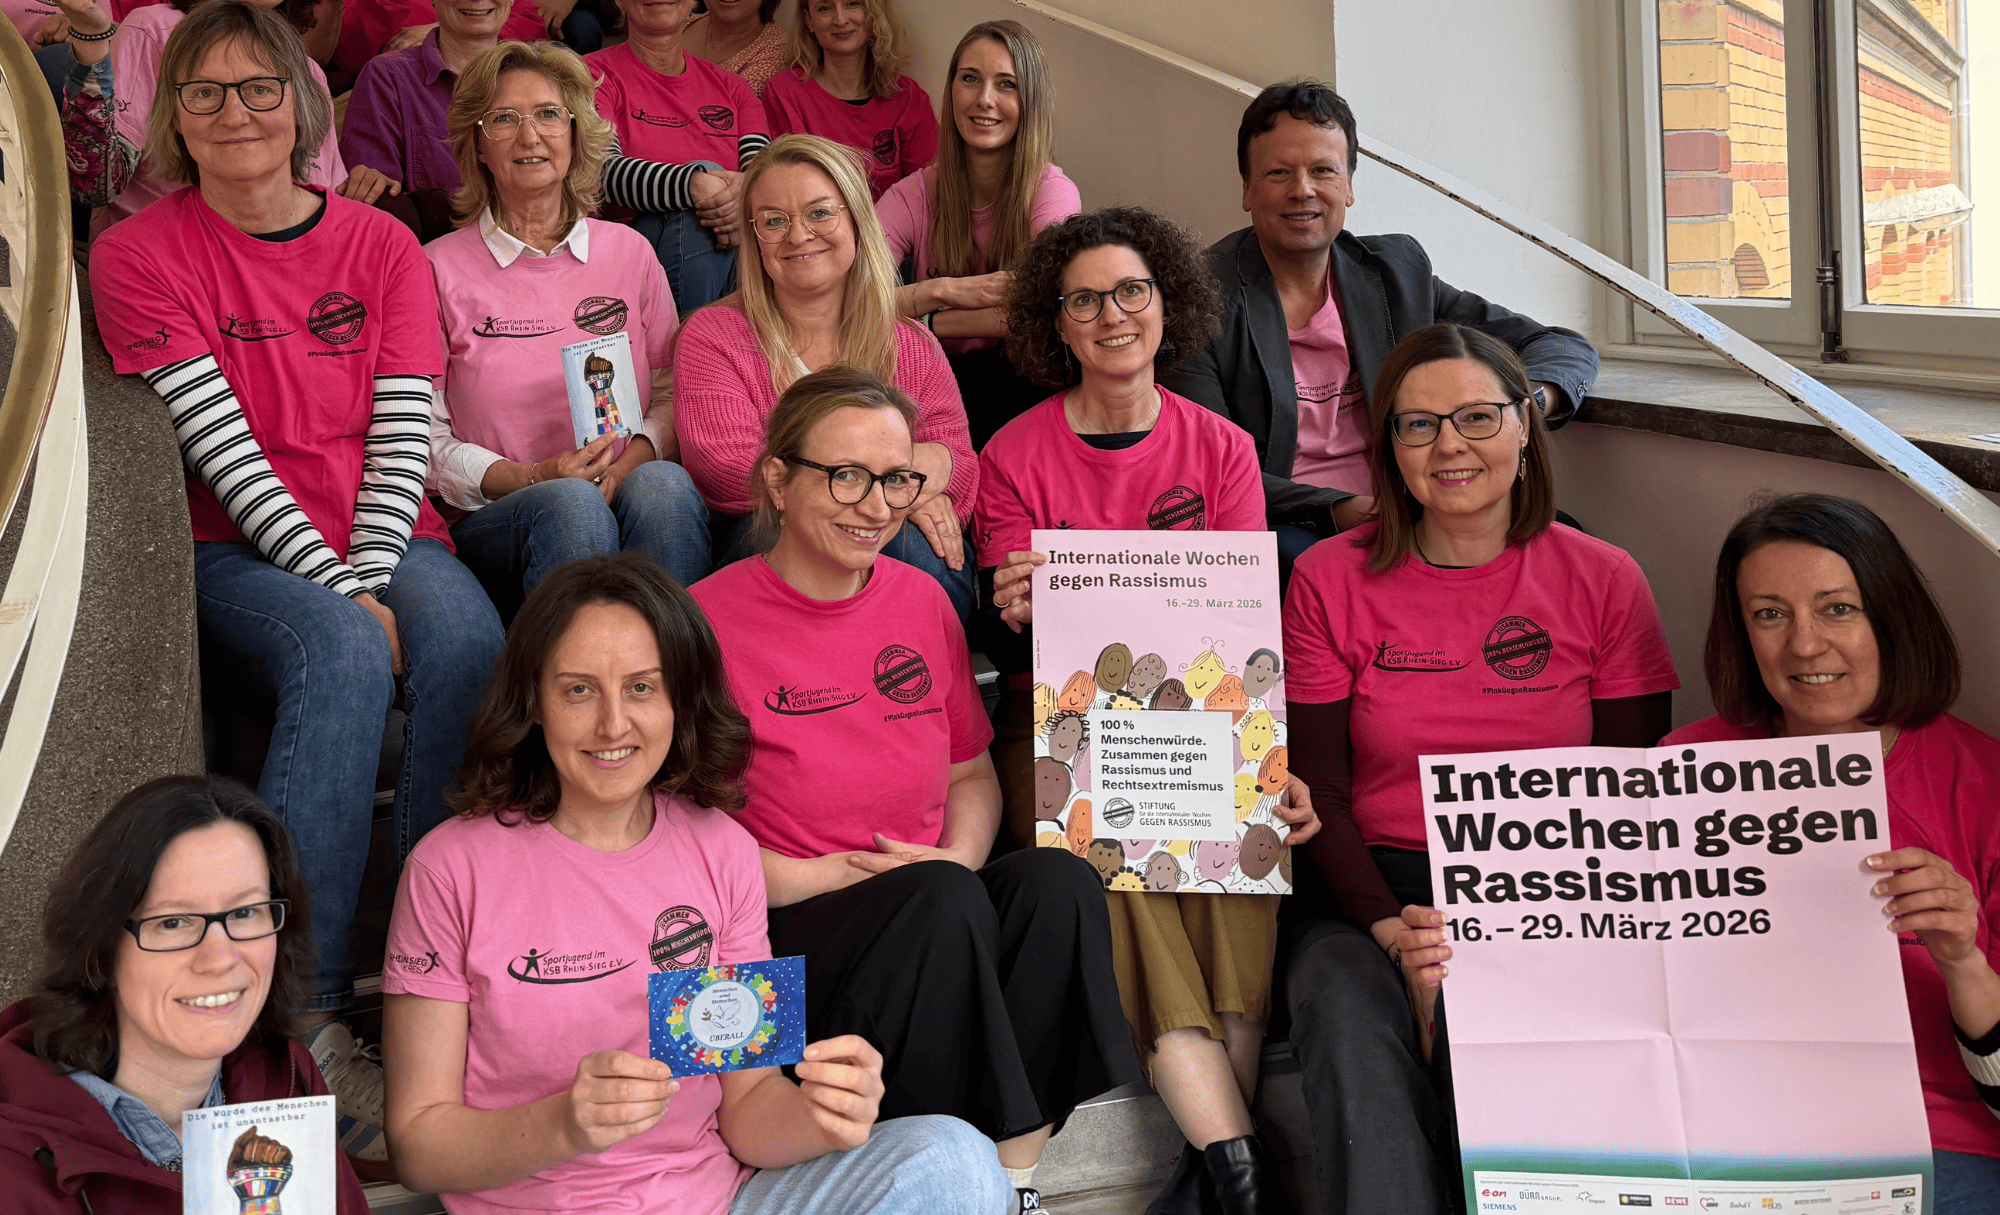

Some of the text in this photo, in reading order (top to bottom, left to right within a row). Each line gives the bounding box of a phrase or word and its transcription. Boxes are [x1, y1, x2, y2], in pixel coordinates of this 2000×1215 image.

[1049, 550, 1260, 566] Internationale Wochen
[1049, 572, 1208, 590] gegen Rassismus
[1206, 599, 1233, 608] März
[1237, 599, 1262, 608] 2026
[791, 687, 831, 699] Sportjugend
[792, 700, 806, 709] KSB
[1100, 720, 1135, 730] 100 %
[1101, 735, 1206, 746] Menschenwürde.
[1101, 750, 1207, 762] Zusammen gegen
[1101, 764, 1192, 776] Rassismus und
[1430, 744, 1874, 803] Internationale
[1102, 780, 1224, 791] Rechtsextremismus
[1139, 802, 1176, 810] STIFTUNG
[1139, 818, 1212, 827] GEGEN RASSISMUS
[1434, 806, 1879, 857] Wochen gegen
[1443, 856, 1767, 905] Rassismus
[1580, 912, 1672, 941] März
[1681, 909, 1772, 937] 2026
[653, 945, 670, 956] 100%
[409, 957, 427, 967] SIEG
[543, 950, 606, 966] Sportjugend im
[543, 966, 560, 976] KSB
[709, 1032, 745, 1042] ÜBERALL
[187, 1100, 328, 1121] Die Würde des Menschen
[211, 1114, 306, 1130] ist unantastbar
